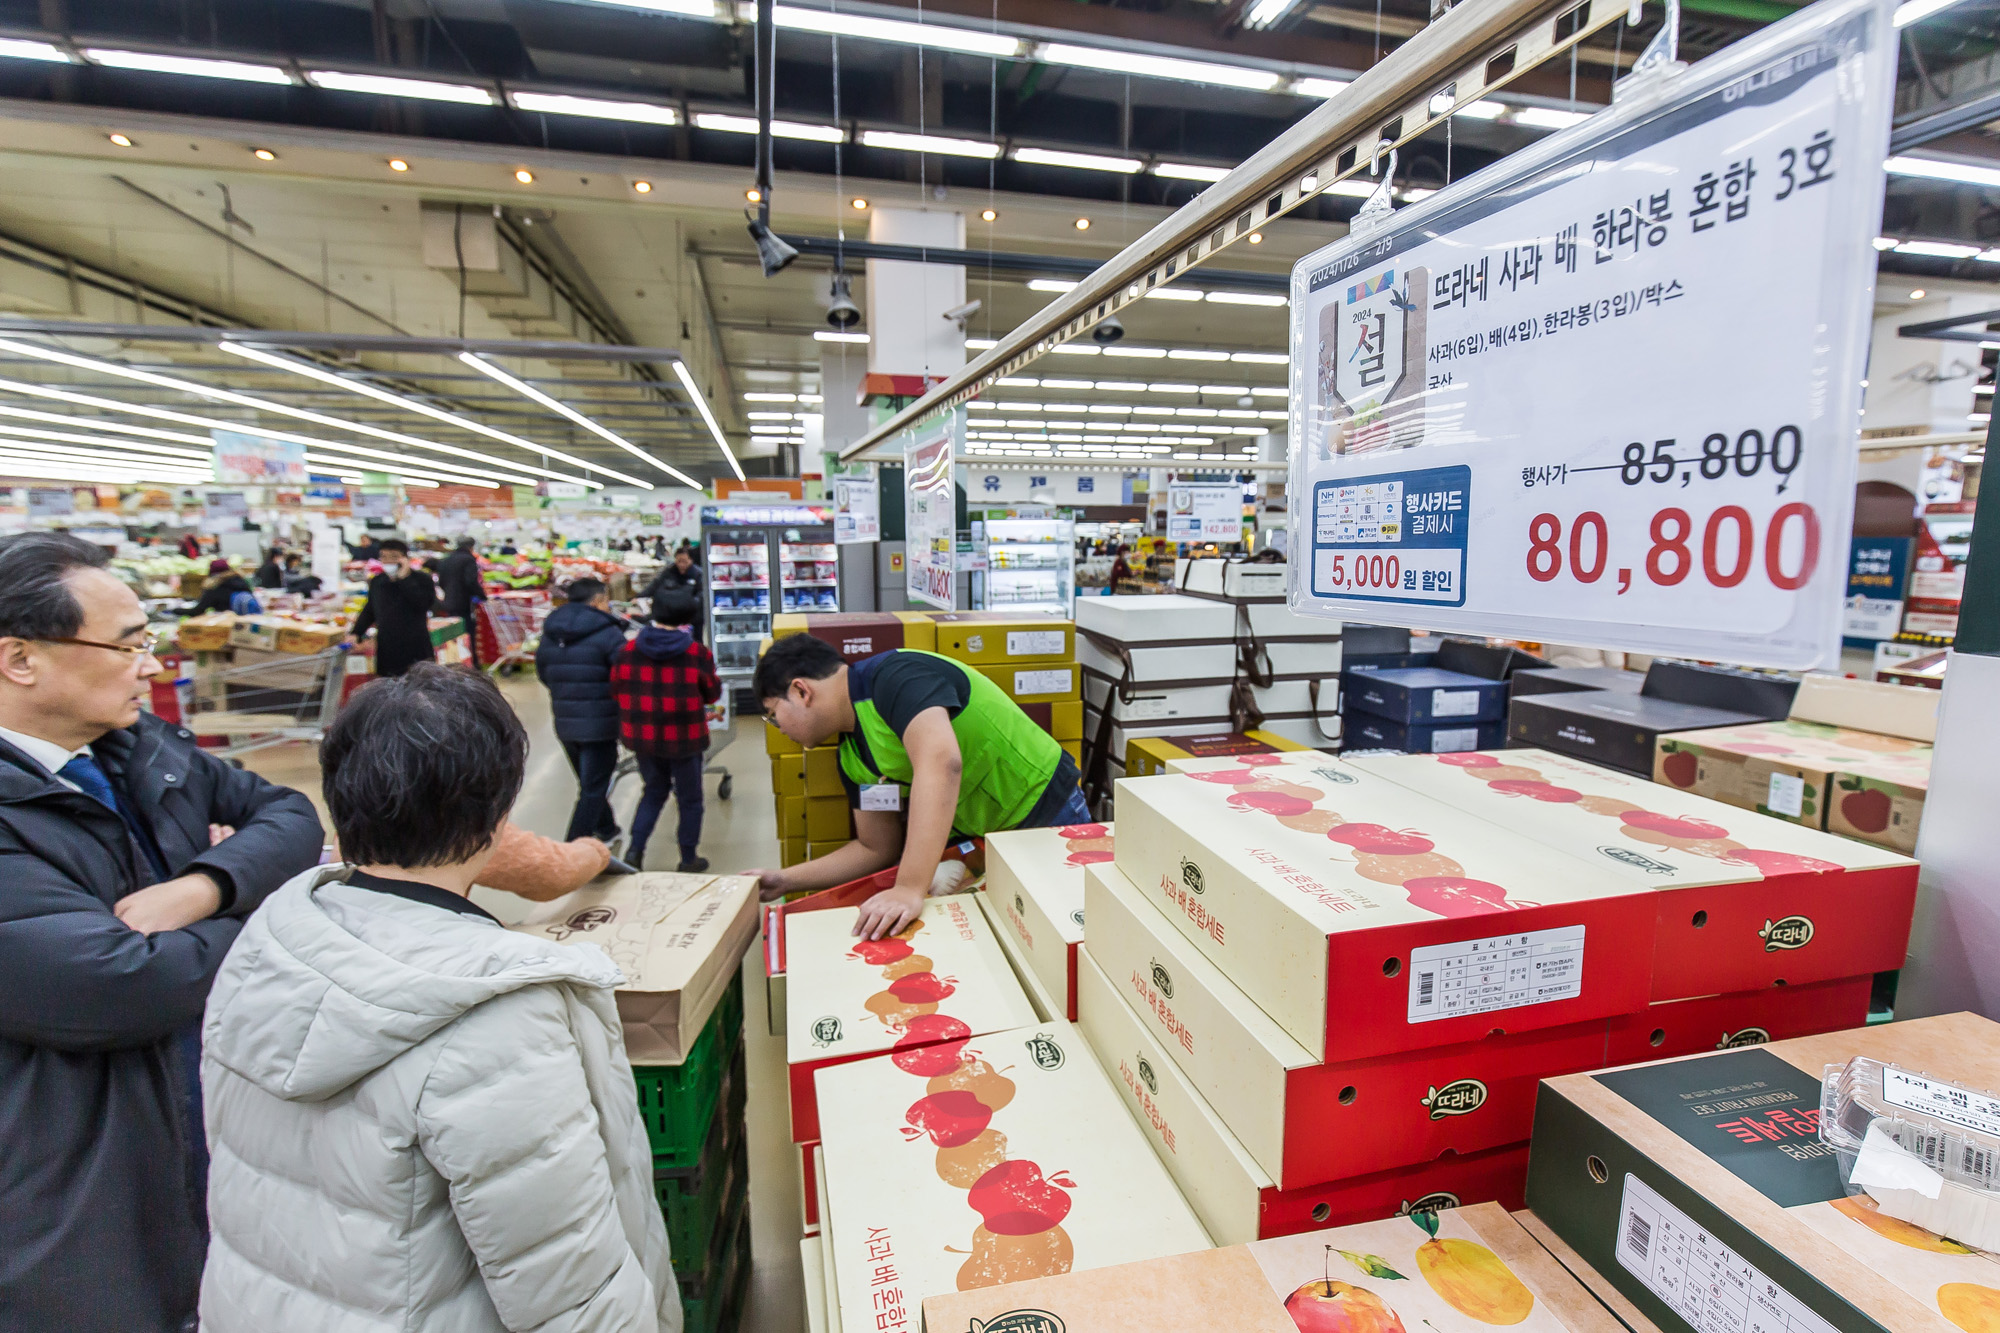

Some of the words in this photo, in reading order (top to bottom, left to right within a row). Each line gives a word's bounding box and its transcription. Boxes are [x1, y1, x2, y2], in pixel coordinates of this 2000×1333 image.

[1433, 256, 1488, 310] 뜨라네
[1499, 236, 1542, 292] 사과
[1555, 223, 1578, 273] 배
[1593, 188, 1673, 265] 한라봉
[1689, 157, 1757, 233] 혼합
[1775, 129, 1836, 201] 3호
[1312, 256, 1359, 284] 2024/1/26
[1375, 236, 1393, 256] 2/9
[1352, 308, 1372, 324] 2024
[1348, 313, 1386, 388] 설
[1522, 463, 1568, 488] 행사가
[1621, 424, 1803, 489] 85,800
[1321, 491, 1335, 500] NH
[1344, 489, 1355, 497] NH
[1406, 491, 1462, 514] 행사카드
[1386, 525, 1397, 534] pay
[1412, 514, 1453, 535] 결제시
[1526, 501, 1822, 595] 80,800
[1422, 570, 1452, 592] 할인
[1244, 848, 1283, 864] 사과
[1273, 865, 1300, 875] 배
[1283, 874, 1357, 914] 혼합세트
[1160, 874, 1176, 904] 사과
[1178, 889, 1187, 913] 배
[1187, 897, 1224, 946] 혼합세트
[1772, 925, 1808, 942] 뜨라네
[1131, 970, 1147, 1002] 사과
[1149, 989, 1157, 1014] 배
[1158, 999, 1193, 1055] 혼합세트
[1120, 1059, 1134, 1092] 사과
[1438, 1088, 1480, 1108] 뜨라네
[1744, 1090, 1799, 1107] PREMIUM
[1893, 1075, 1928, 1090] 사과
[1948, 1090, 1968, 1101] 배
[1690, 1103, 1713, 1116] SET
[1713, 1098, 1750, 1112] FRUIT
[864, 1227, 895, 1262] 사과
[1698, 1232, 1706, 1245] 표
[1720, 1250, 1730, 1262] 시
[1742, 1267, 1753, 1280] 사
[871, 1264, 899, 1287] 배
[873, 1287, 908, 1333] 혼합
